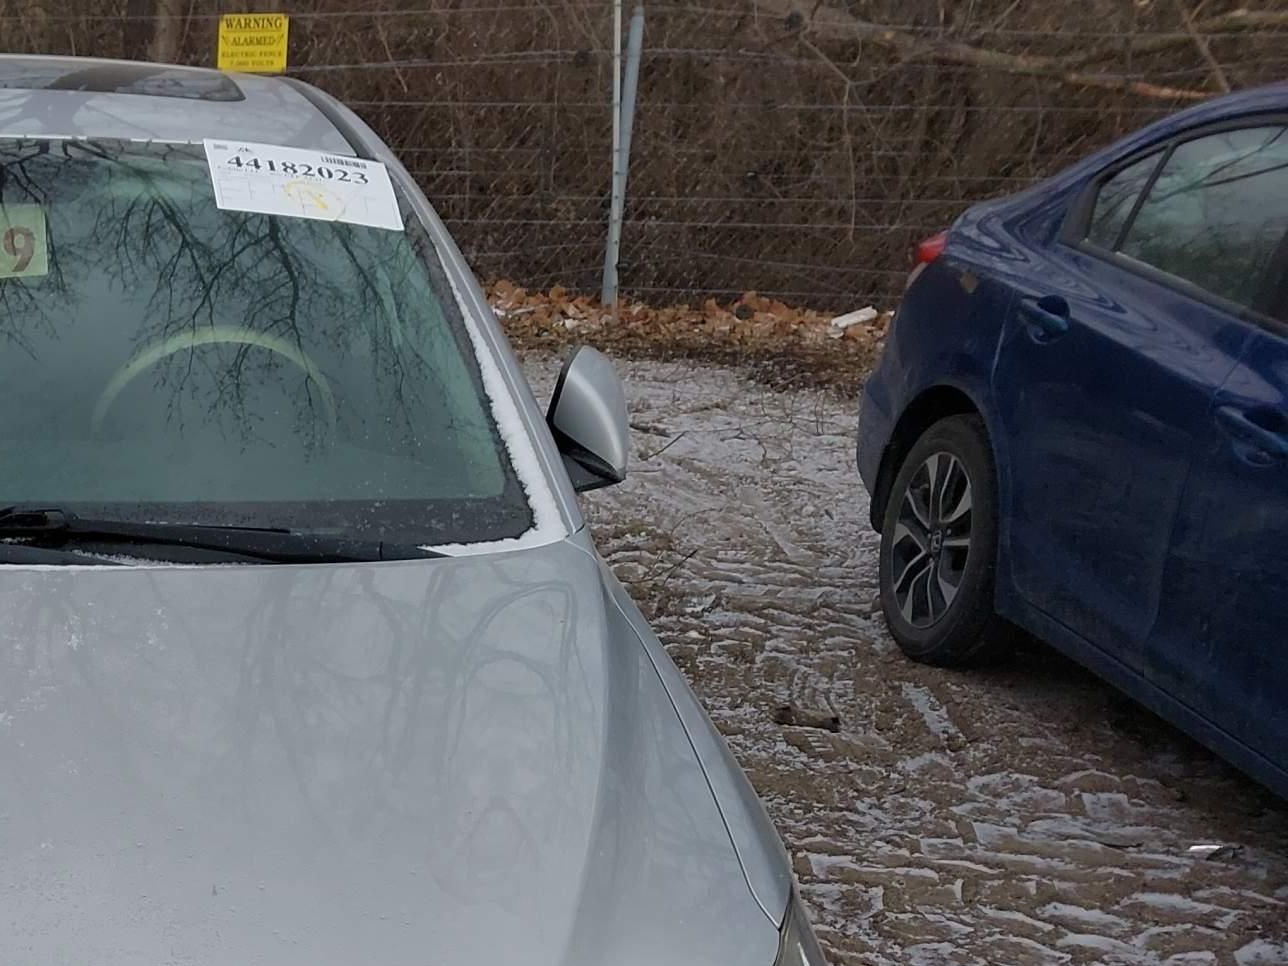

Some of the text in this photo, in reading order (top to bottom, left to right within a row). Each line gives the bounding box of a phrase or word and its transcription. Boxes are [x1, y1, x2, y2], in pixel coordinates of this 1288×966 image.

[225, 16, 283, 29] WARNING
[231, 35, 276, 46] ALARMED
[227, 155, 368, 184] 44182023
